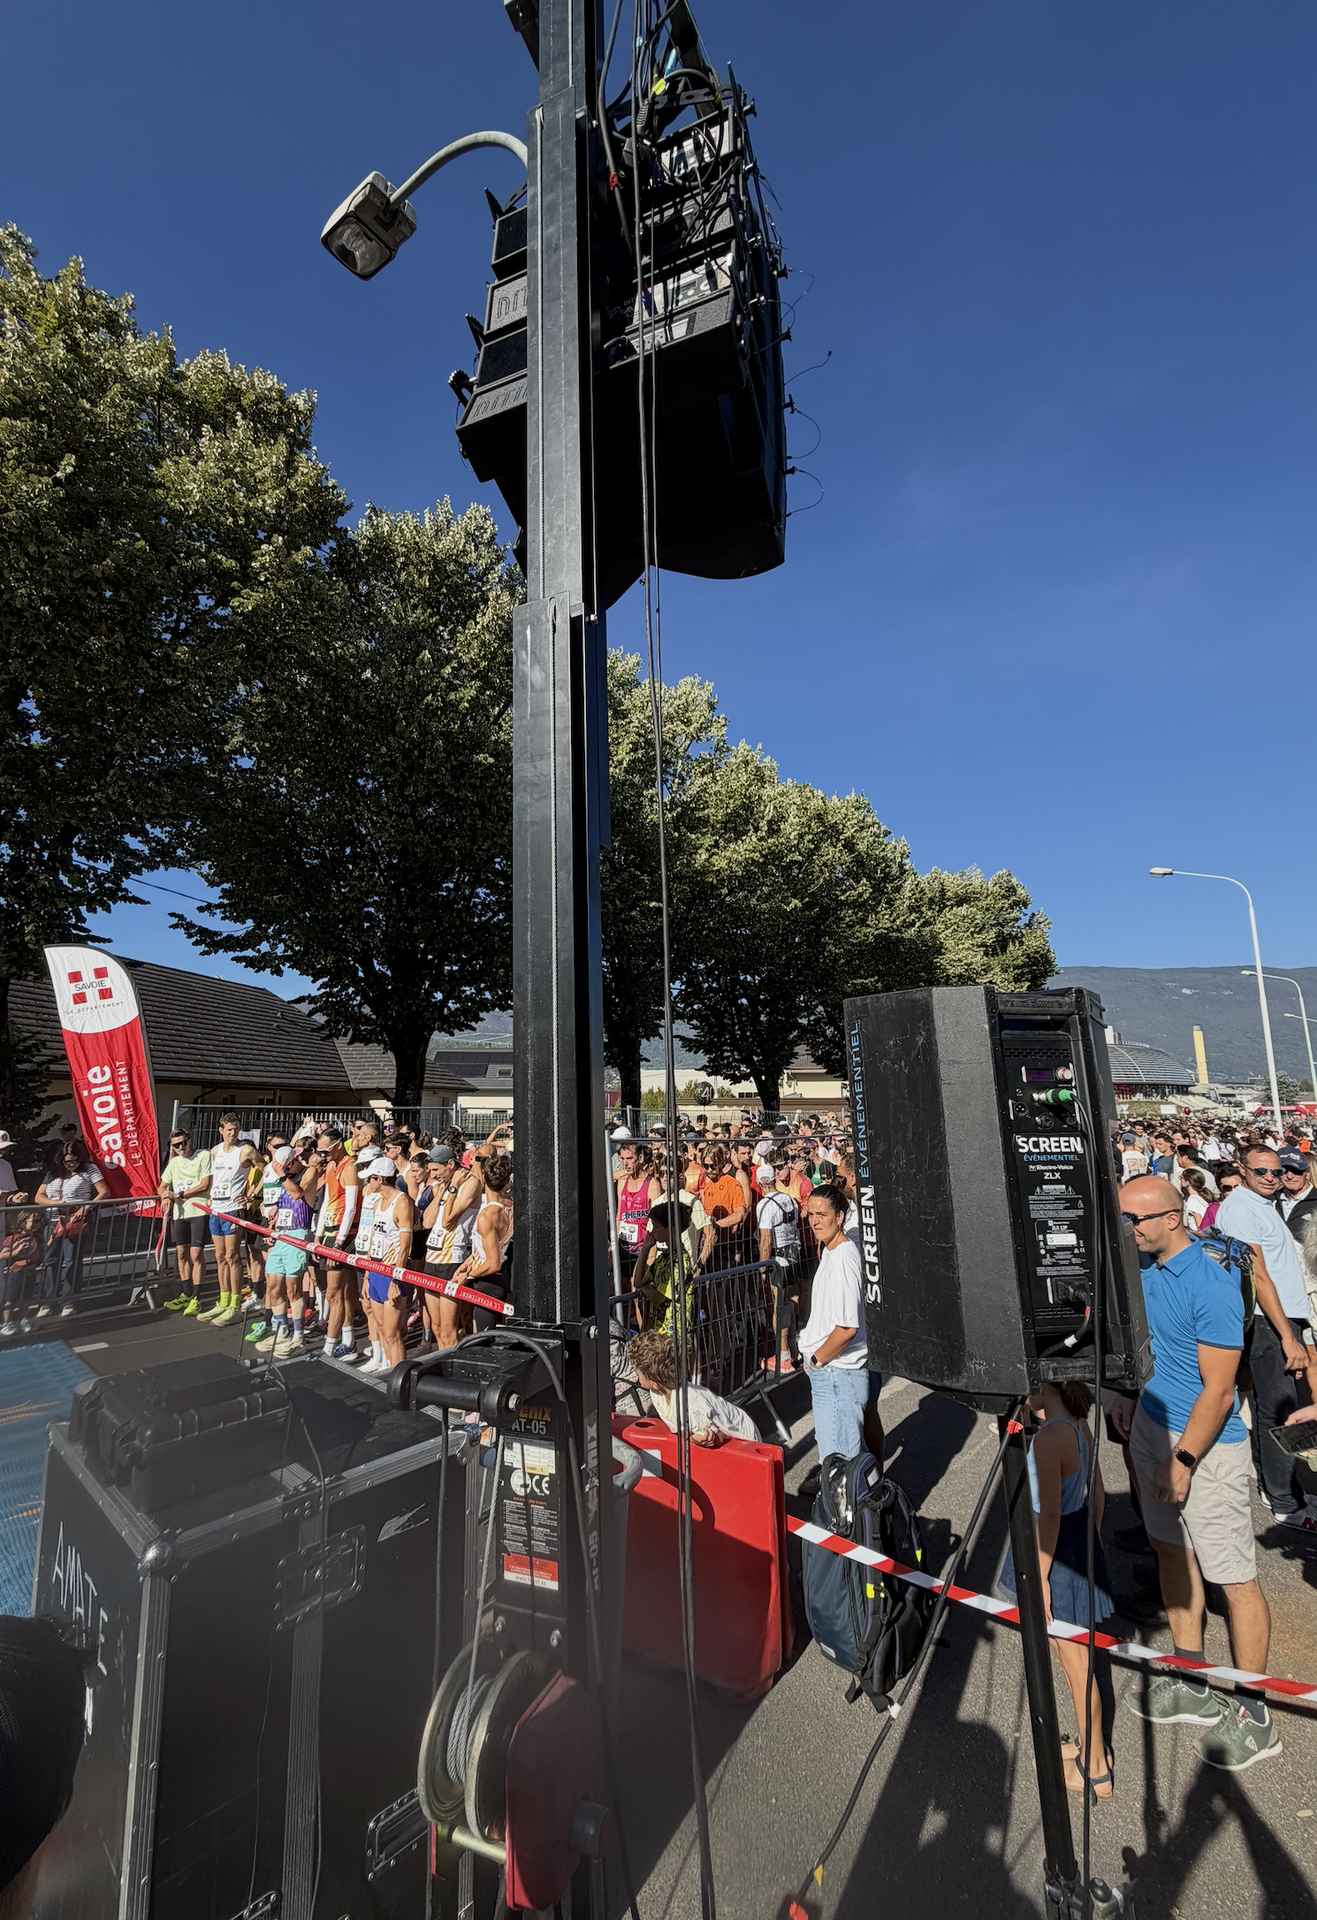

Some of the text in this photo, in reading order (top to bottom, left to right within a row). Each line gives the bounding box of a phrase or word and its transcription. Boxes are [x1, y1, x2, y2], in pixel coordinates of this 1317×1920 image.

[74, 980, 107, 992] SAVOIE
[83, 1064, 126, 1170] savoie
[116, 1060, 143, 1167] LE DÉPARTEMENT
[1017, 1136, 1083, 1153] SCREEN
[850, 1021, 881, 1305] SCREEN ÉVÉNEMENTIEL
[1023, 1153, 1080, 1162] ÉVÉNEMENTIEL
[1043, 1172, 1061, 1180] ZLX
[436, 1282, 443, 1290] LE
[511, 1418, 547, 1435] AT-05
